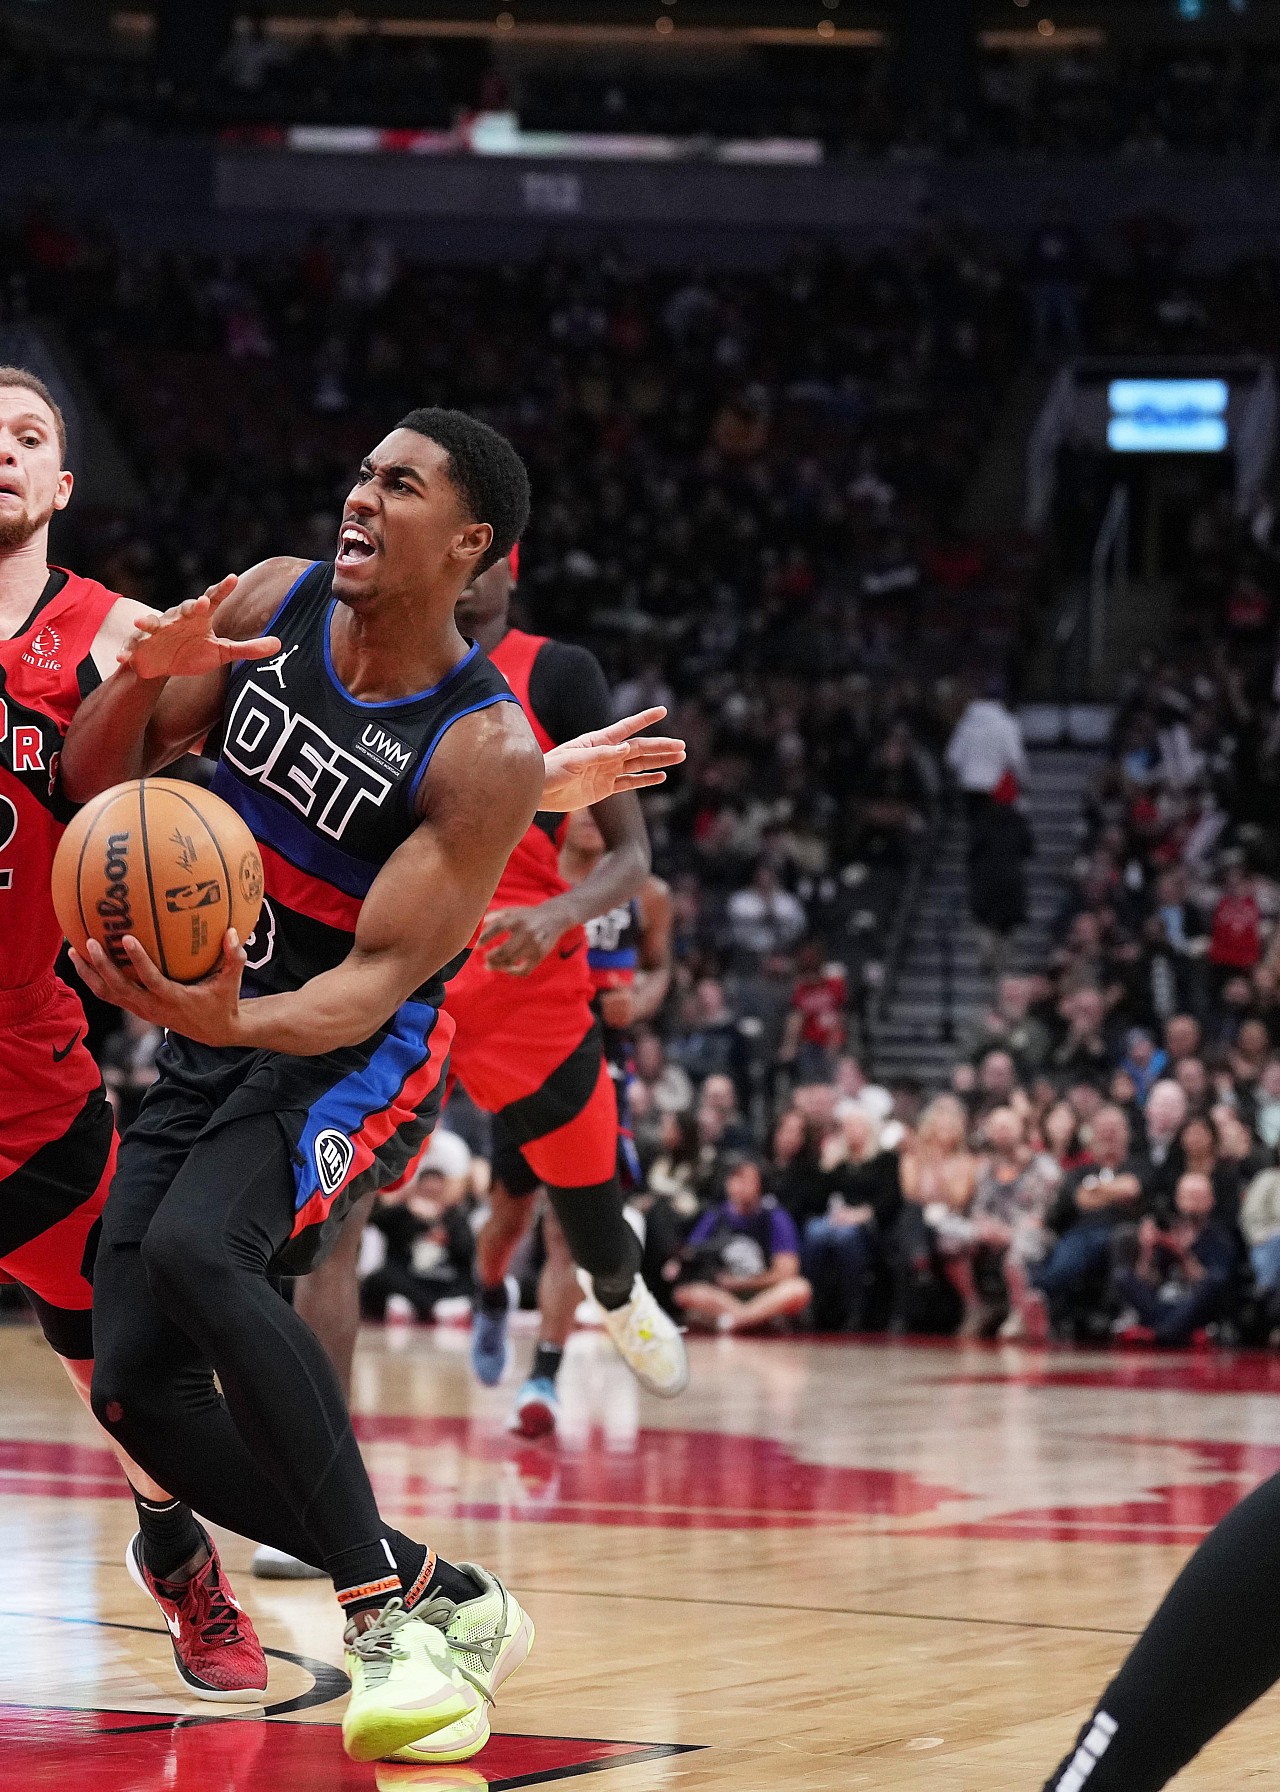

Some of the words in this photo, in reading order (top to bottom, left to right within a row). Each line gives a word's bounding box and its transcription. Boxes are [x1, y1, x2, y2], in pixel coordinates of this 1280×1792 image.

[22, 652, 34, 664] un
[37, 658, 61, 670] Life
[223, 679, 393, 840] DET
[361, 723, 412, 771] UWM
